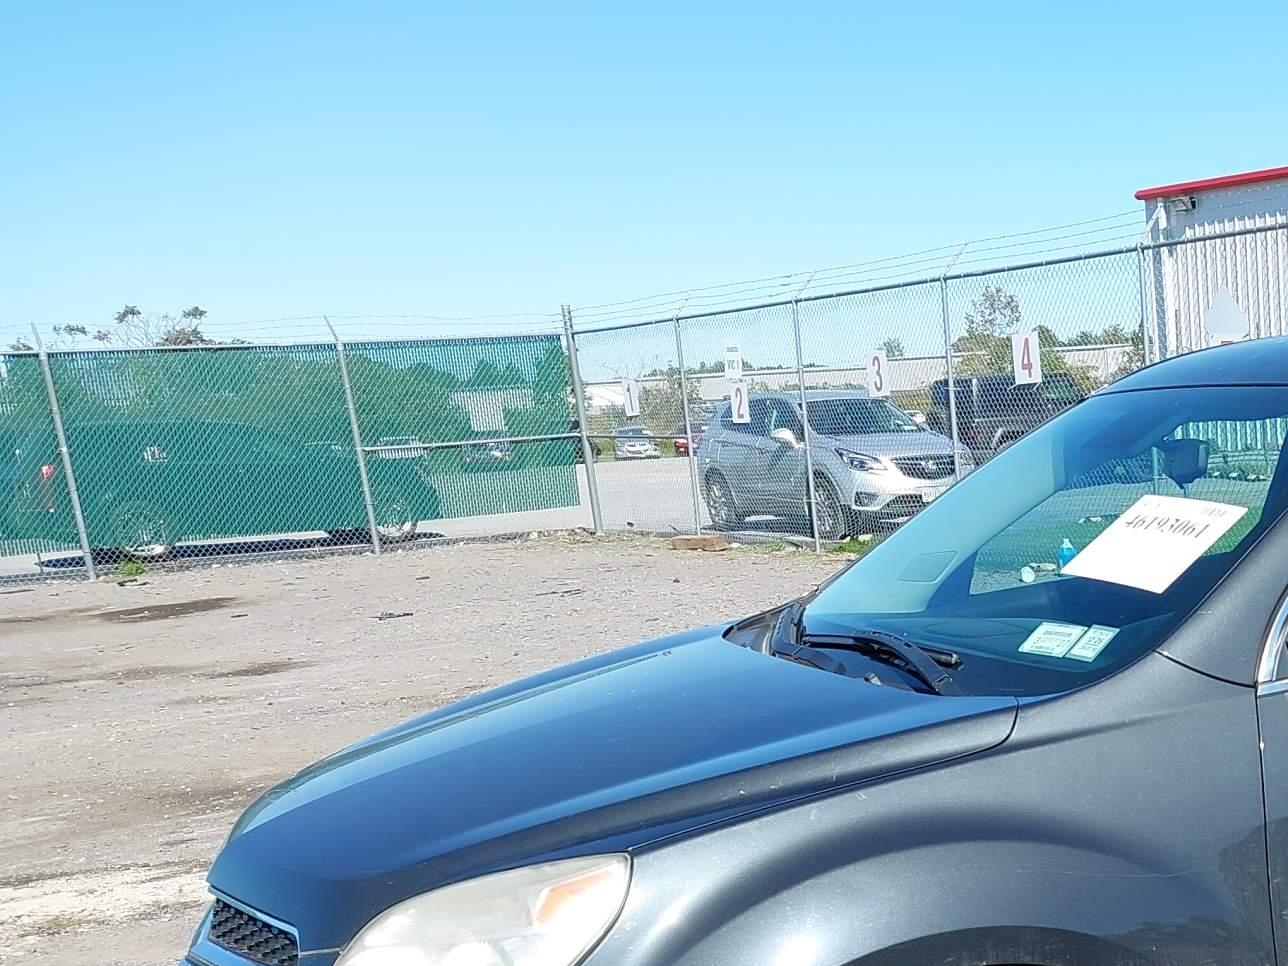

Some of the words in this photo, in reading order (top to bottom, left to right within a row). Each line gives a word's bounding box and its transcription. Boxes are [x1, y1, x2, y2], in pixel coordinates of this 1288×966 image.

[872, 355, 883, 392] 3
[1021, 337, 1033, 378] 4
[626, 382, 634, 412] 1
[735, 387, 744, 419] 2
[1124, 514, 1210, 538] 46193061
